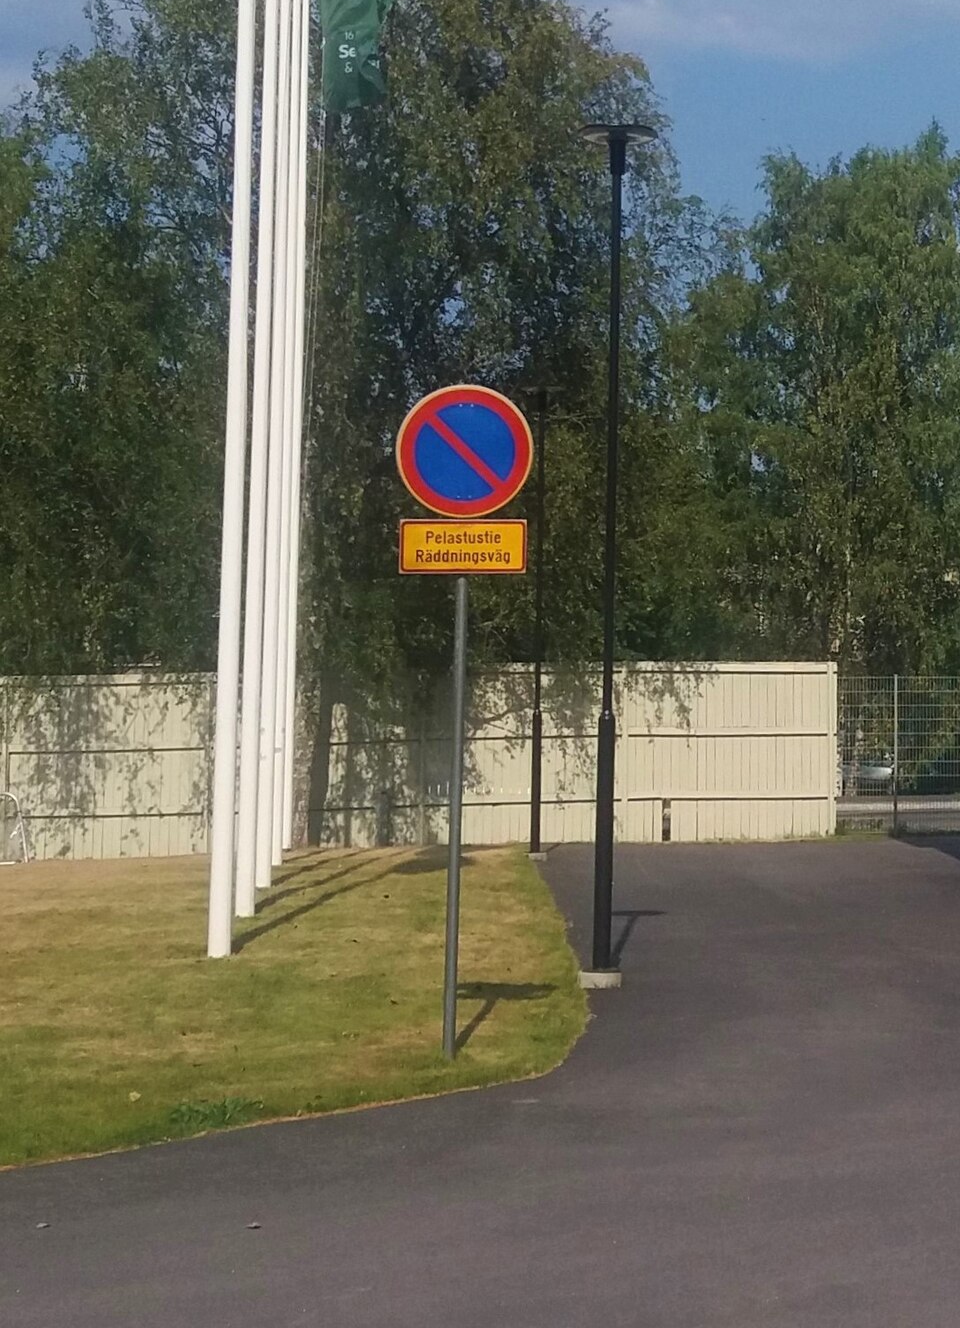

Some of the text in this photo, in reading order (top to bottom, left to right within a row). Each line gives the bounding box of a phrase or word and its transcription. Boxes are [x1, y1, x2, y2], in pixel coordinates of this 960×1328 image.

[344, 62, 353, 74] &
[425, 530, 501, 544] Pelastustie
[415, 549, 511, 564] Räddningsväg
